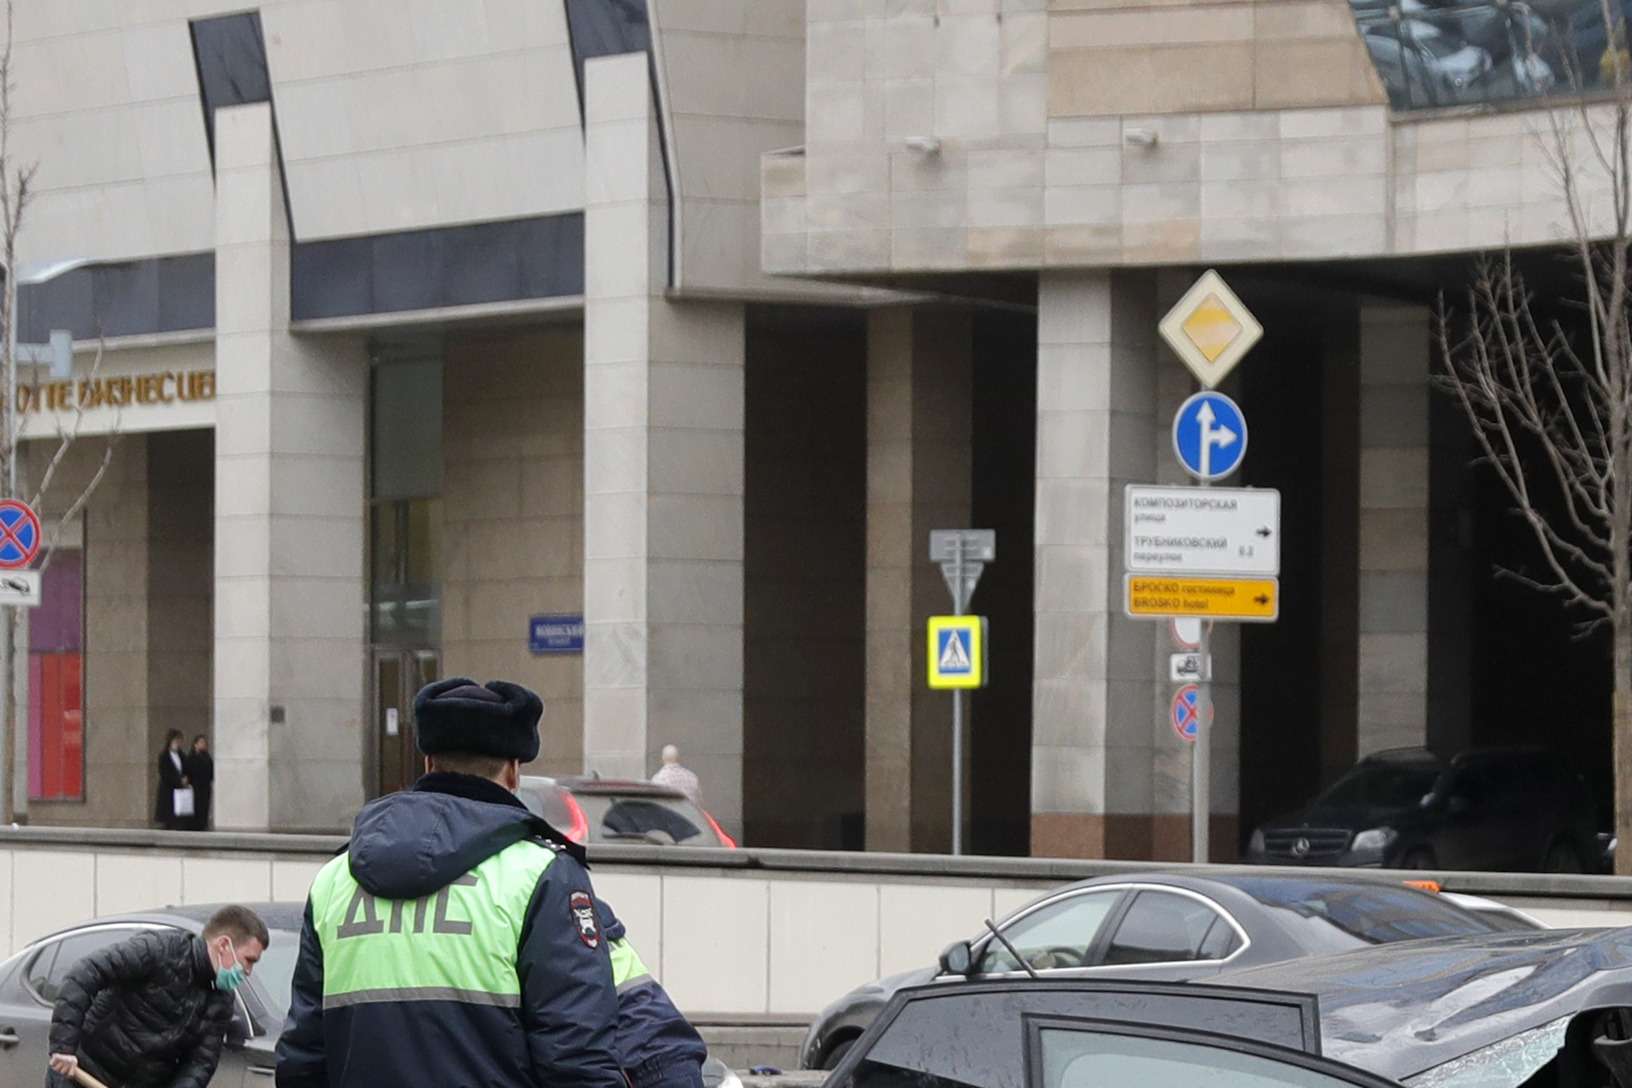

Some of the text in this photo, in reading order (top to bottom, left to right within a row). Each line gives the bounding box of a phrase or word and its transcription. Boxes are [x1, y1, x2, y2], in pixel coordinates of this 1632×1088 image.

[15, 382, 73, 414] ОТТЕ
[1134, 497, 1238, 510] КОМПОЗИТОРСКАЯ
[1134, 535, 1227, 549] ТРУБНИКОВСКИЙ
